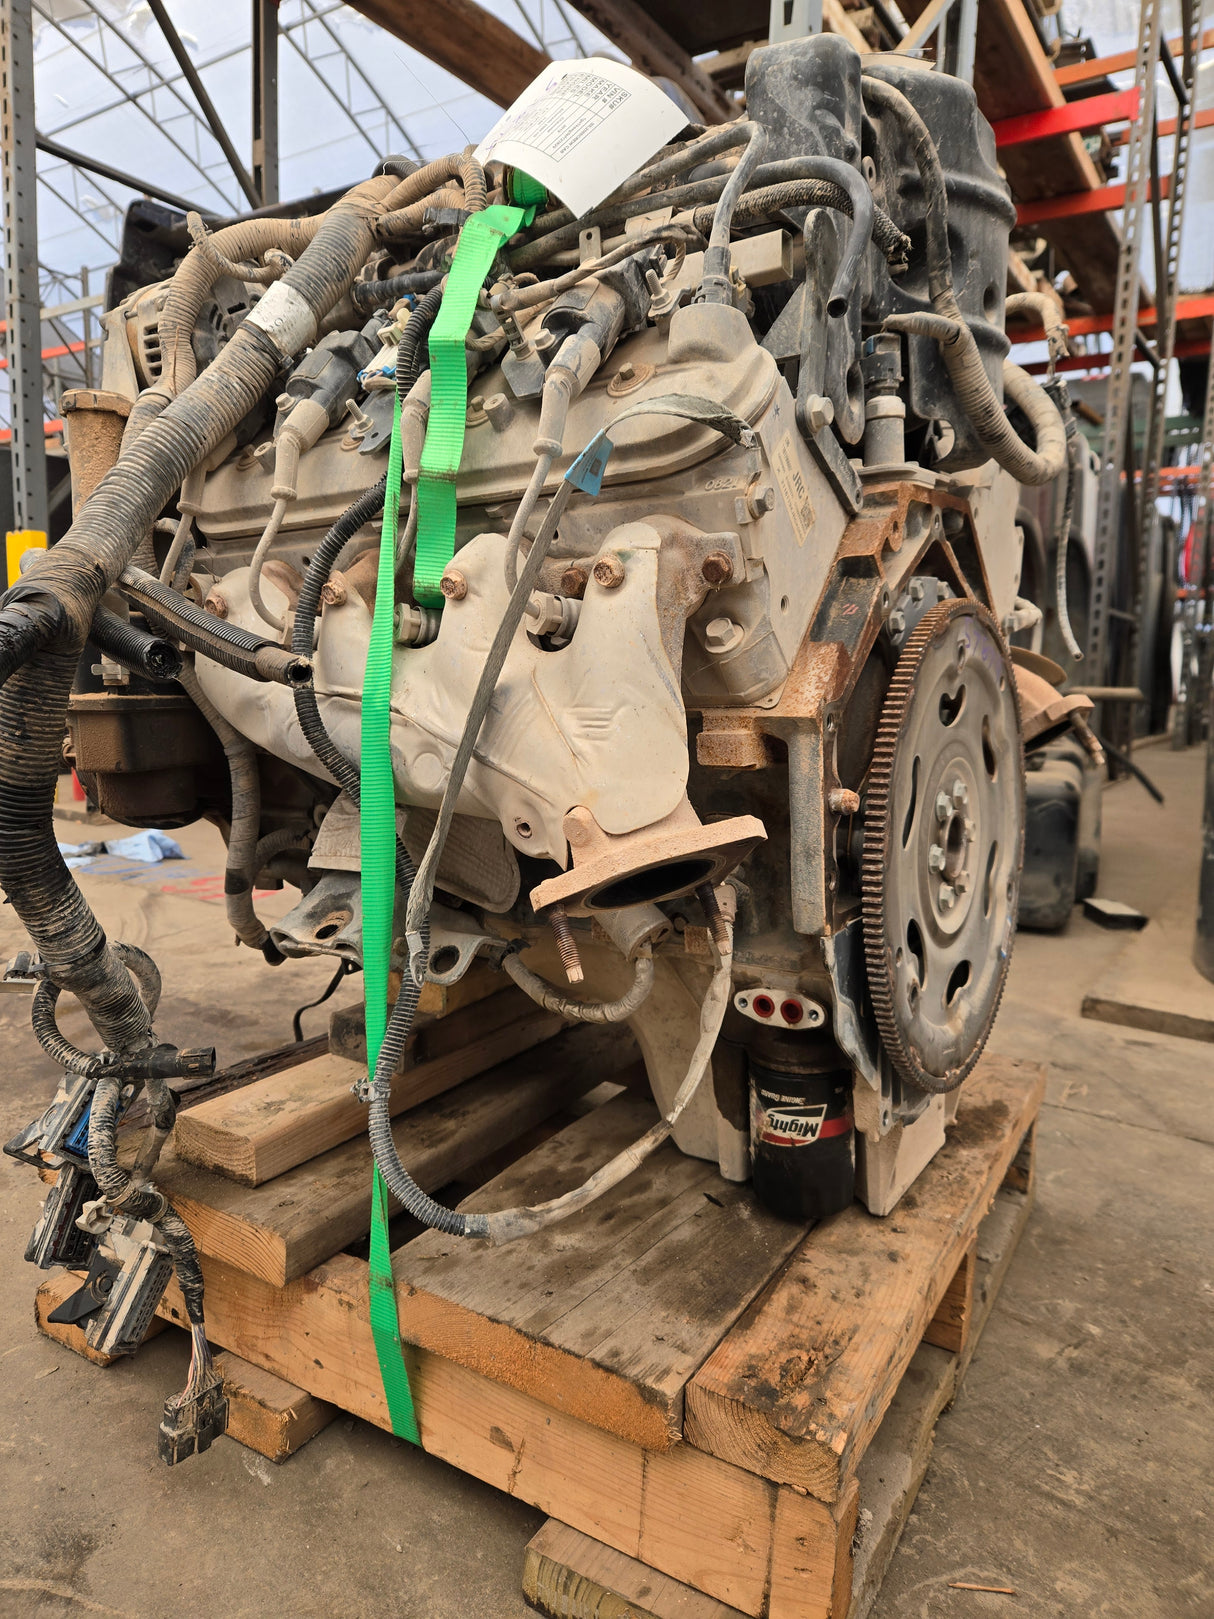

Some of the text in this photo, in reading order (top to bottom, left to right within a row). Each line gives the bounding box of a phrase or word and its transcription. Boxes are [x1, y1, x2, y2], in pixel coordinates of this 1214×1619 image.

[592, 83, 612, 100] YEAR
[606, 87, 621, 99] VIN
[608, 91, 628, 110] SKU#
[767, 1113, 819, 1137] Mighty
